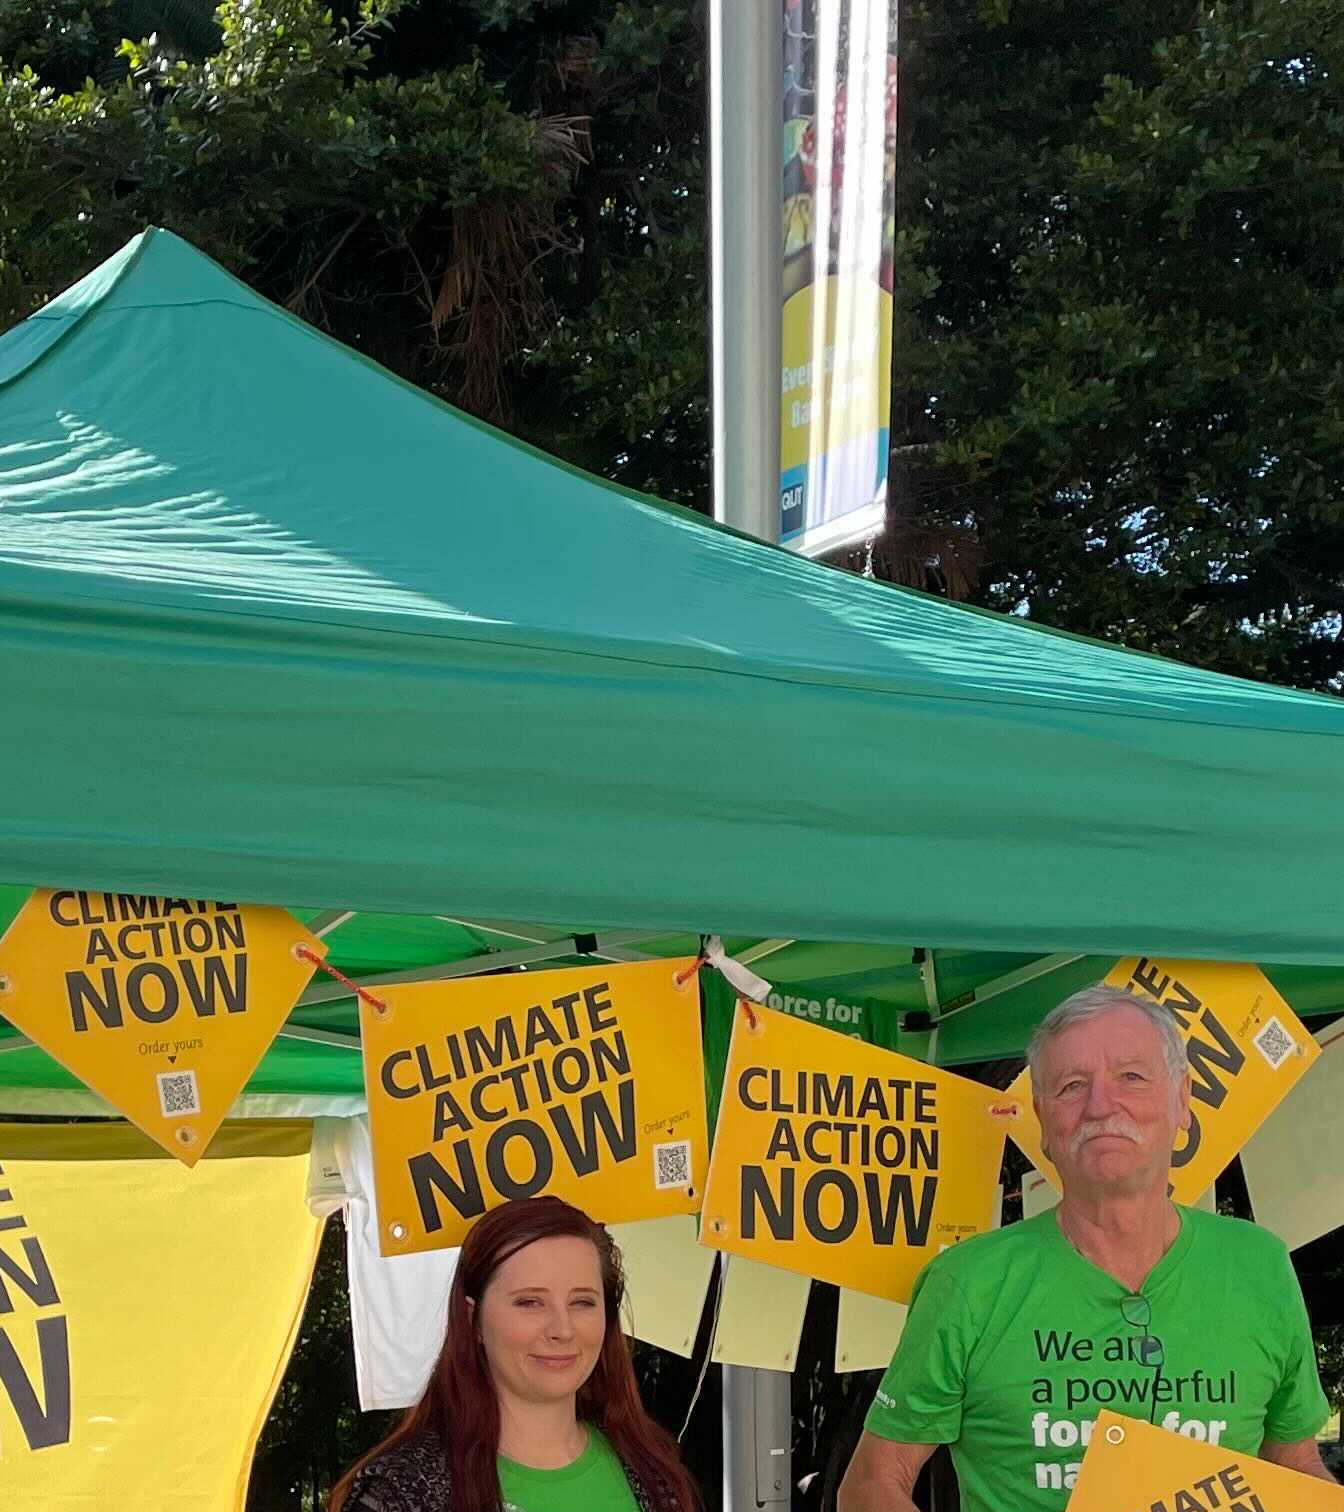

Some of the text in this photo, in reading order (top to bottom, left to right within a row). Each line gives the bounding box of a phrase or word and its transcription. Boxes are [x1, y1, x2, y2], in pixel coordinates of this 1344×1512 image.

[86, 914, 247, 965] ACTION
[65, 953, 248, 1032] NOW
[767, 993, 863, 1025] orce for
[138, 1037, 204, 1056] Order yours
[381, 982, 618, 1099] CLIMATE
[432, 1030, 631, 1142] ACTION
[738, 1066, 937, 1124] CLIMATE
[407, 1078, 639, 1233] NOW
[766, 1117, 938, 1170] ACTION
[739, 1165, 938, 1246] NOW
[1034, 1329, 1094, 1362] We
[1032, 1369, 1236, 1410] a powerful
